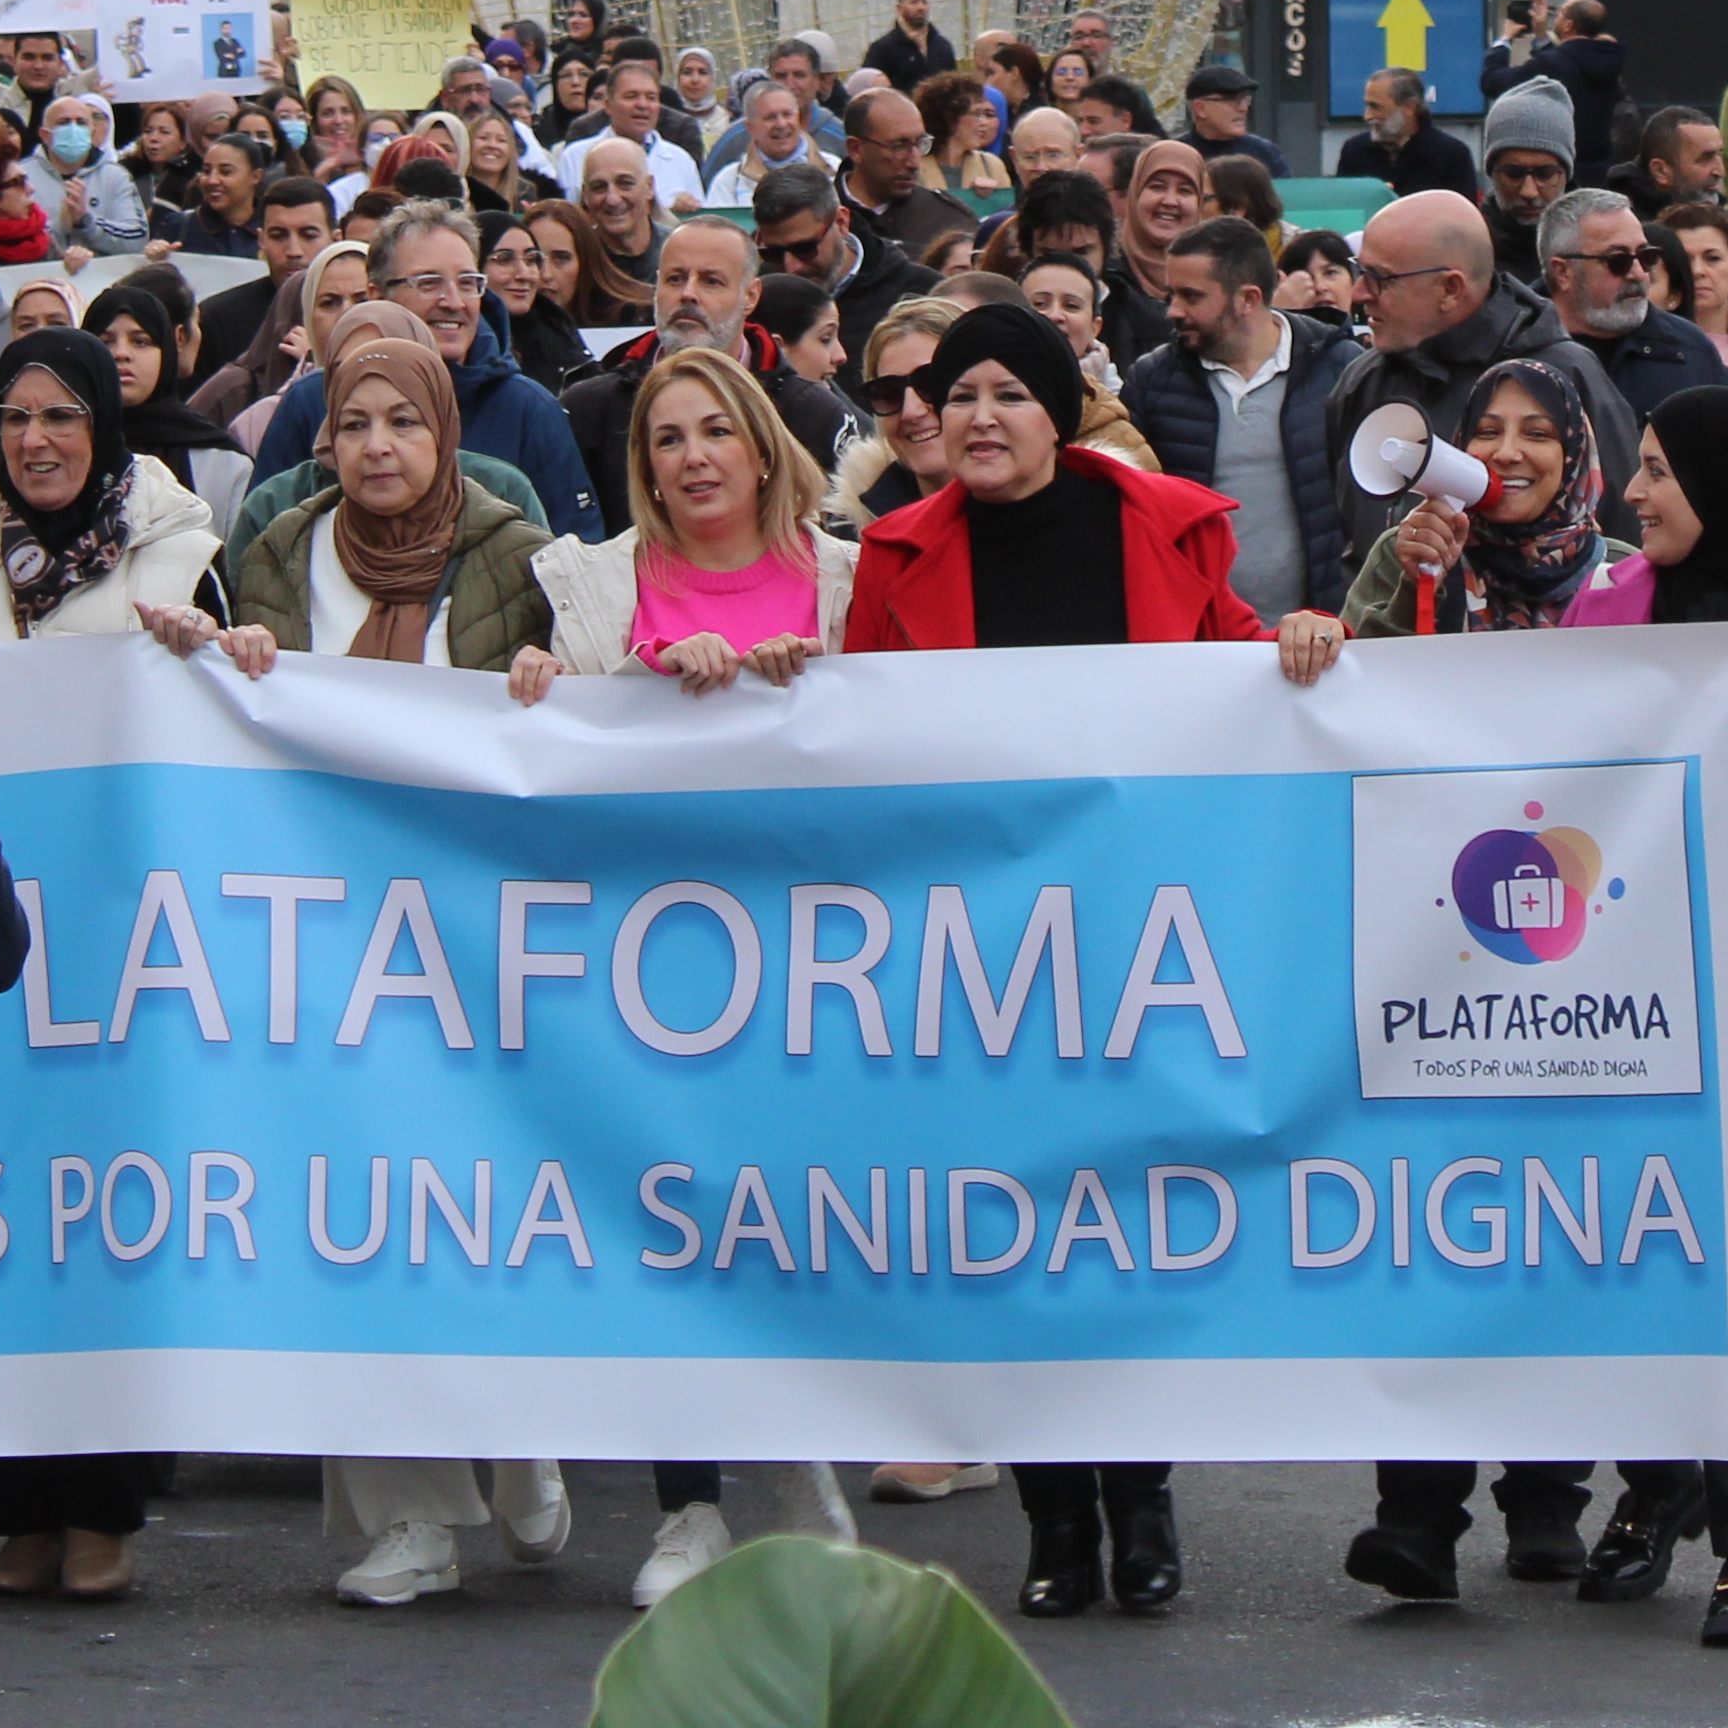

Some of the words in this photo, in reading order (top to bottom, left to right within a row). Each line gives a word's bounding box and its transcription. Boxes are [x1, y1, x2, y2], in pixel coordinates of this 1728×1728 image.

[298, 13, 373, 43] GOBIERNE
[381, 11, 399, 35] LA
[403, 11, 456, 35] SANIDAD
[309, 45, 336, 73] SE
[1504, 1058, 1534, 1078] UNA
[1535, 1059, 1600, 1079] SANIDAD
[1603, 1058, 1649, 1078] DIGNA
[49, 1148, 259, 1265] POR
[306, 1153, 596, 1270] UNA
[637, 1159, 1239, 1278] SANIDAD
[1287, 1152, 1708, 1272] DIGNA
